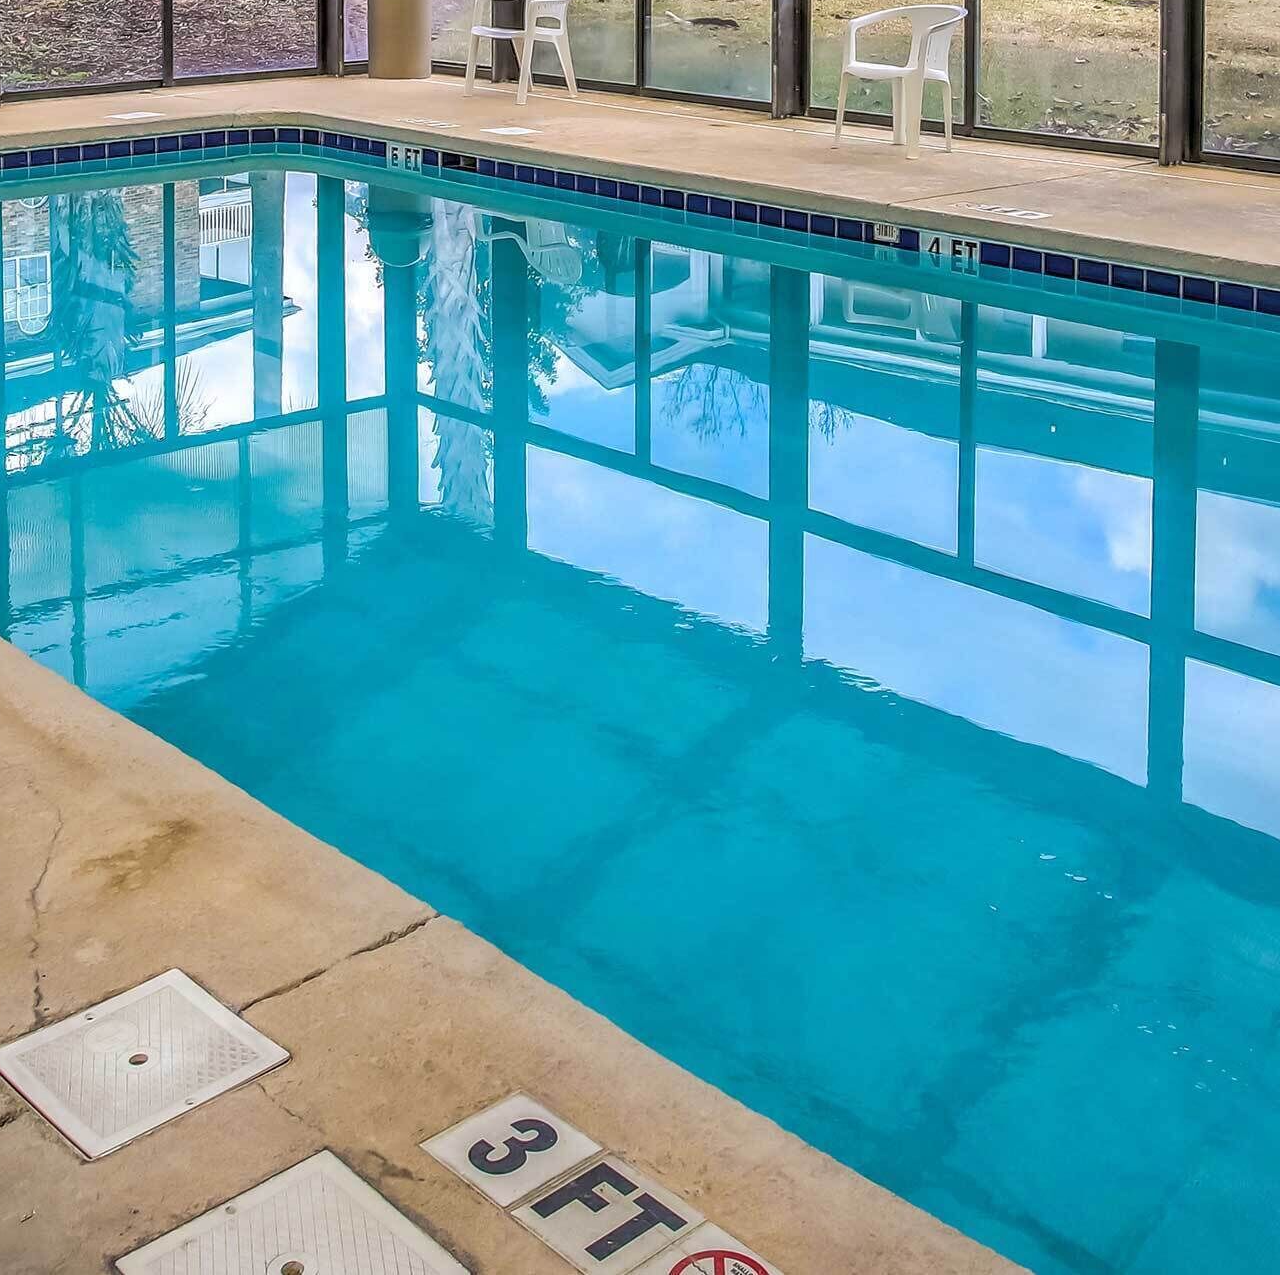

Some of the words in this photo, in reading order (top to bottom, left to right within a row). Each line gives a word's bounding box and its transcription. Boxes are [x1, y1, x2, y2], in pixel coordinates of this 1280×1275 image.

[928, 237, 941, 254] 4
[468, 1118, 560, 1175] 3
[529, 1161, 689, 1262] FT
